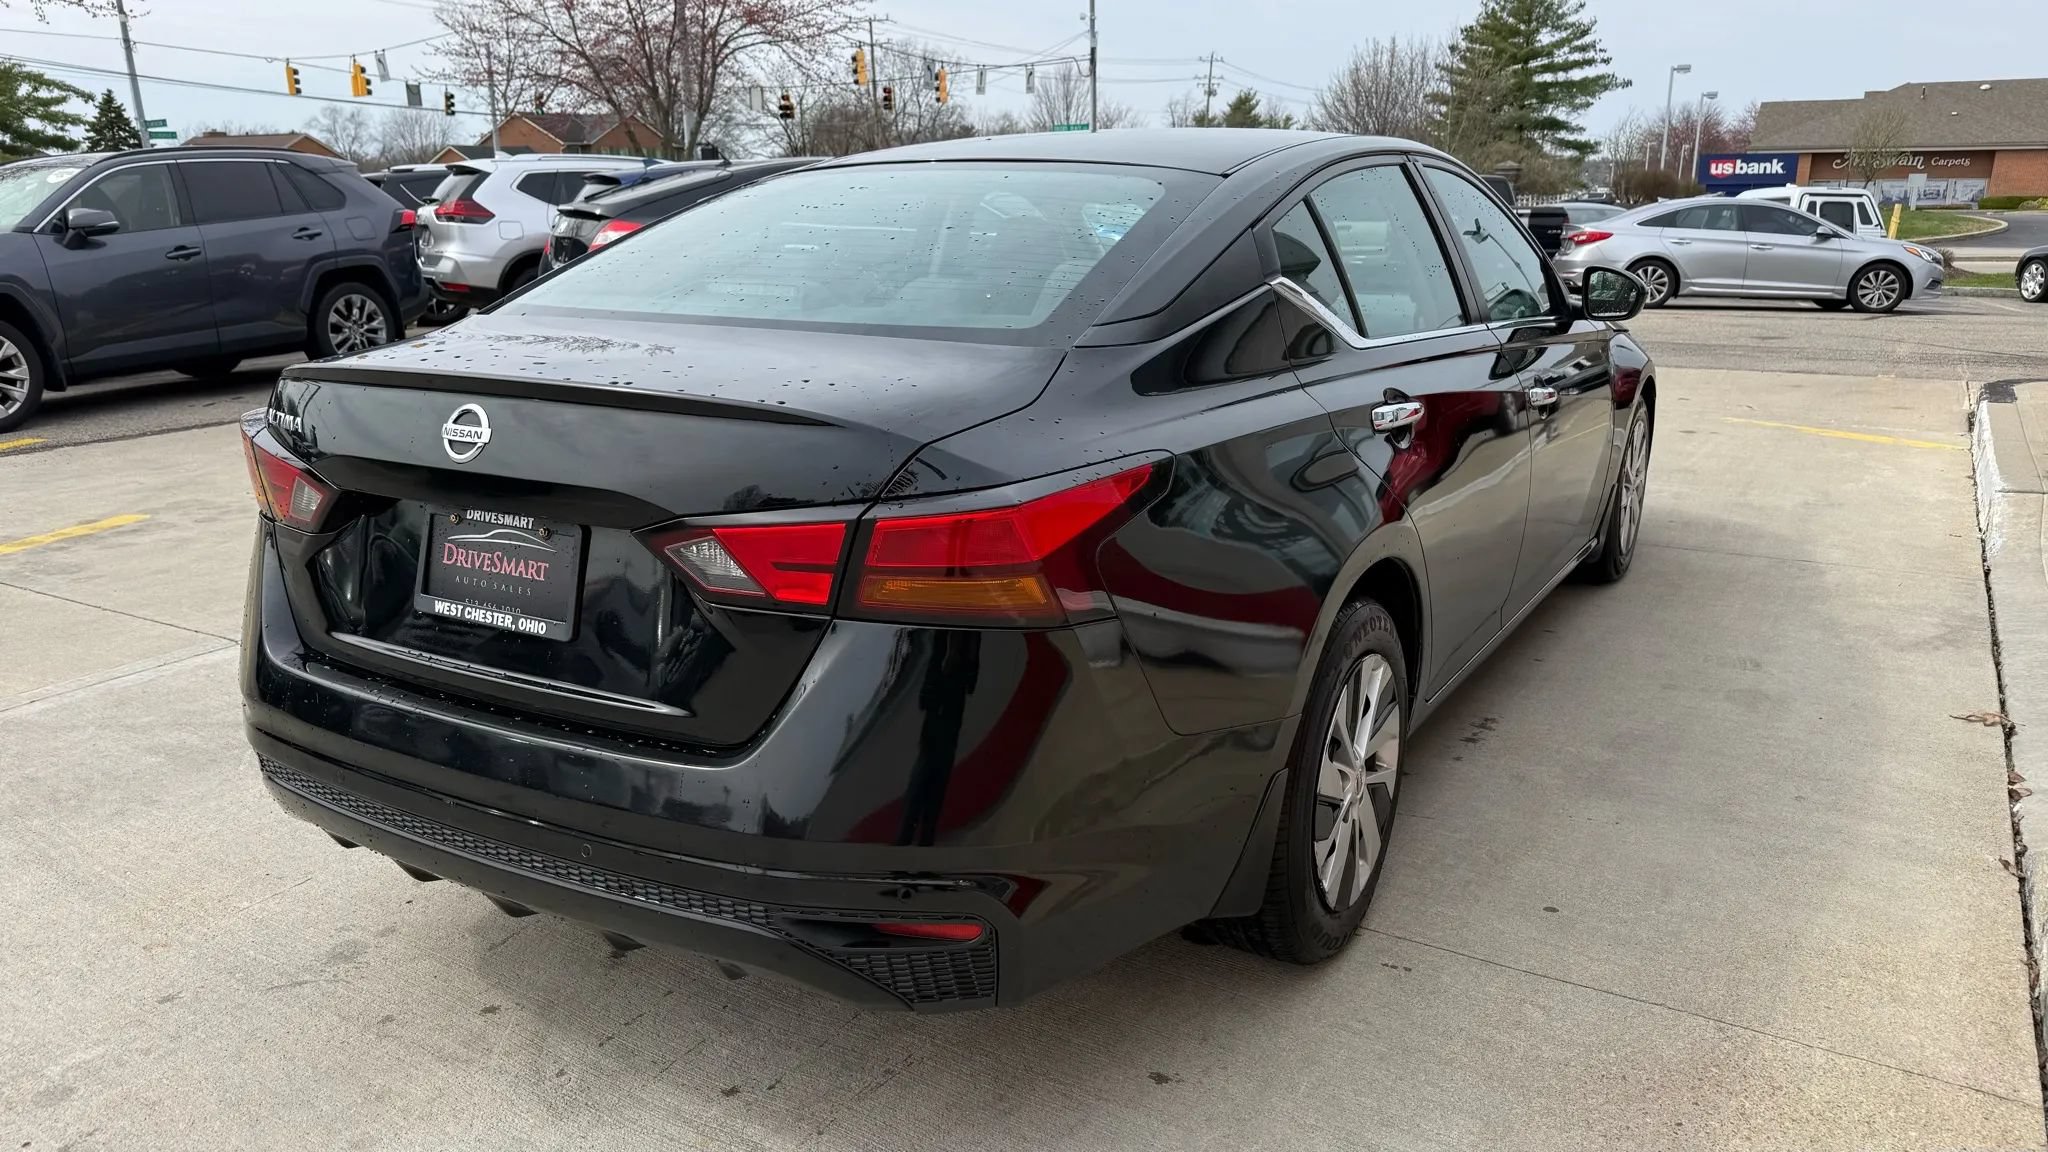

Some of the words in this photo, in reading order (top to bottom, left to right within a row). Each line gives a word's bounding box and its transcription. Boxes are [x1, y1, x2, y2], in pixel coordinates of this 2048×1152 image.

[1930, 156, 1971, 167] Carpets
[443, 426, 483, 440] NISSAN
[466, 509, 534, 529] DRIVESMART
[455, 575, 487, 588] AUTO
[493, 582, 532, 596] SALES
[434, 600, 464, 618] WEST
[464, 606, 516, 631] CHESTER,
[518, 615, 547, 635] OHIO
